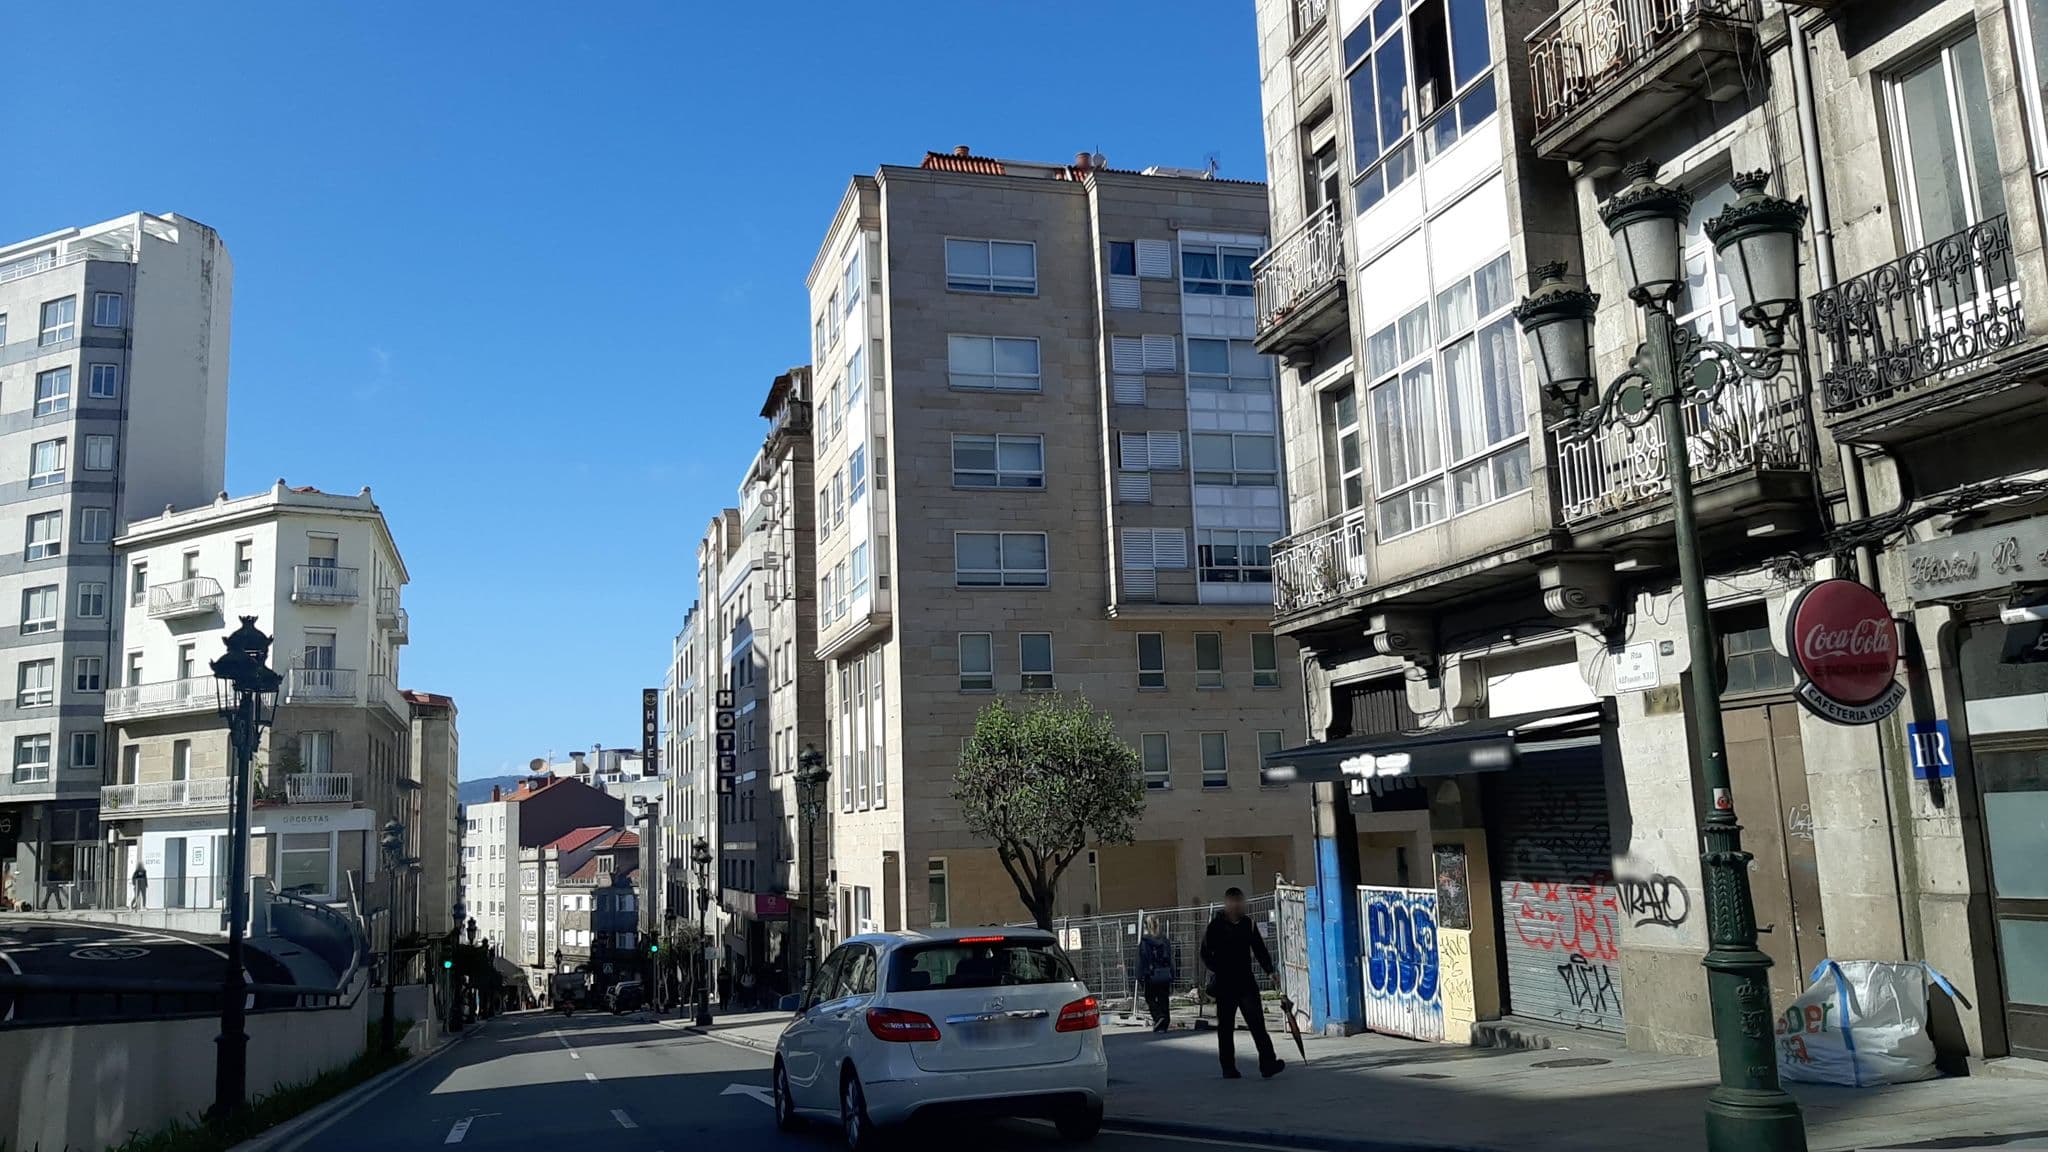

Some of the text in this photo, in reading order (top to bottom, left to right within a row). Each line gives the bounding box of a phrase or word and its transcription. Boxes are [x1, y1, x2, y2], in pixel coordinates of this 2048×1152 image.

[760, 457, 778, 600] HOTEL
[1910, 552, 1979, 587] Hostal
[1804, 618, 1892, 660] Coca-Cola
[1808, 688, 1905, 721] CAFETERIA HOSTAL
[646, 709, 656, 773] HOTEL
[718, 691, 734, 793] HOTEL
[1911, 731, 1950, 768] HR
